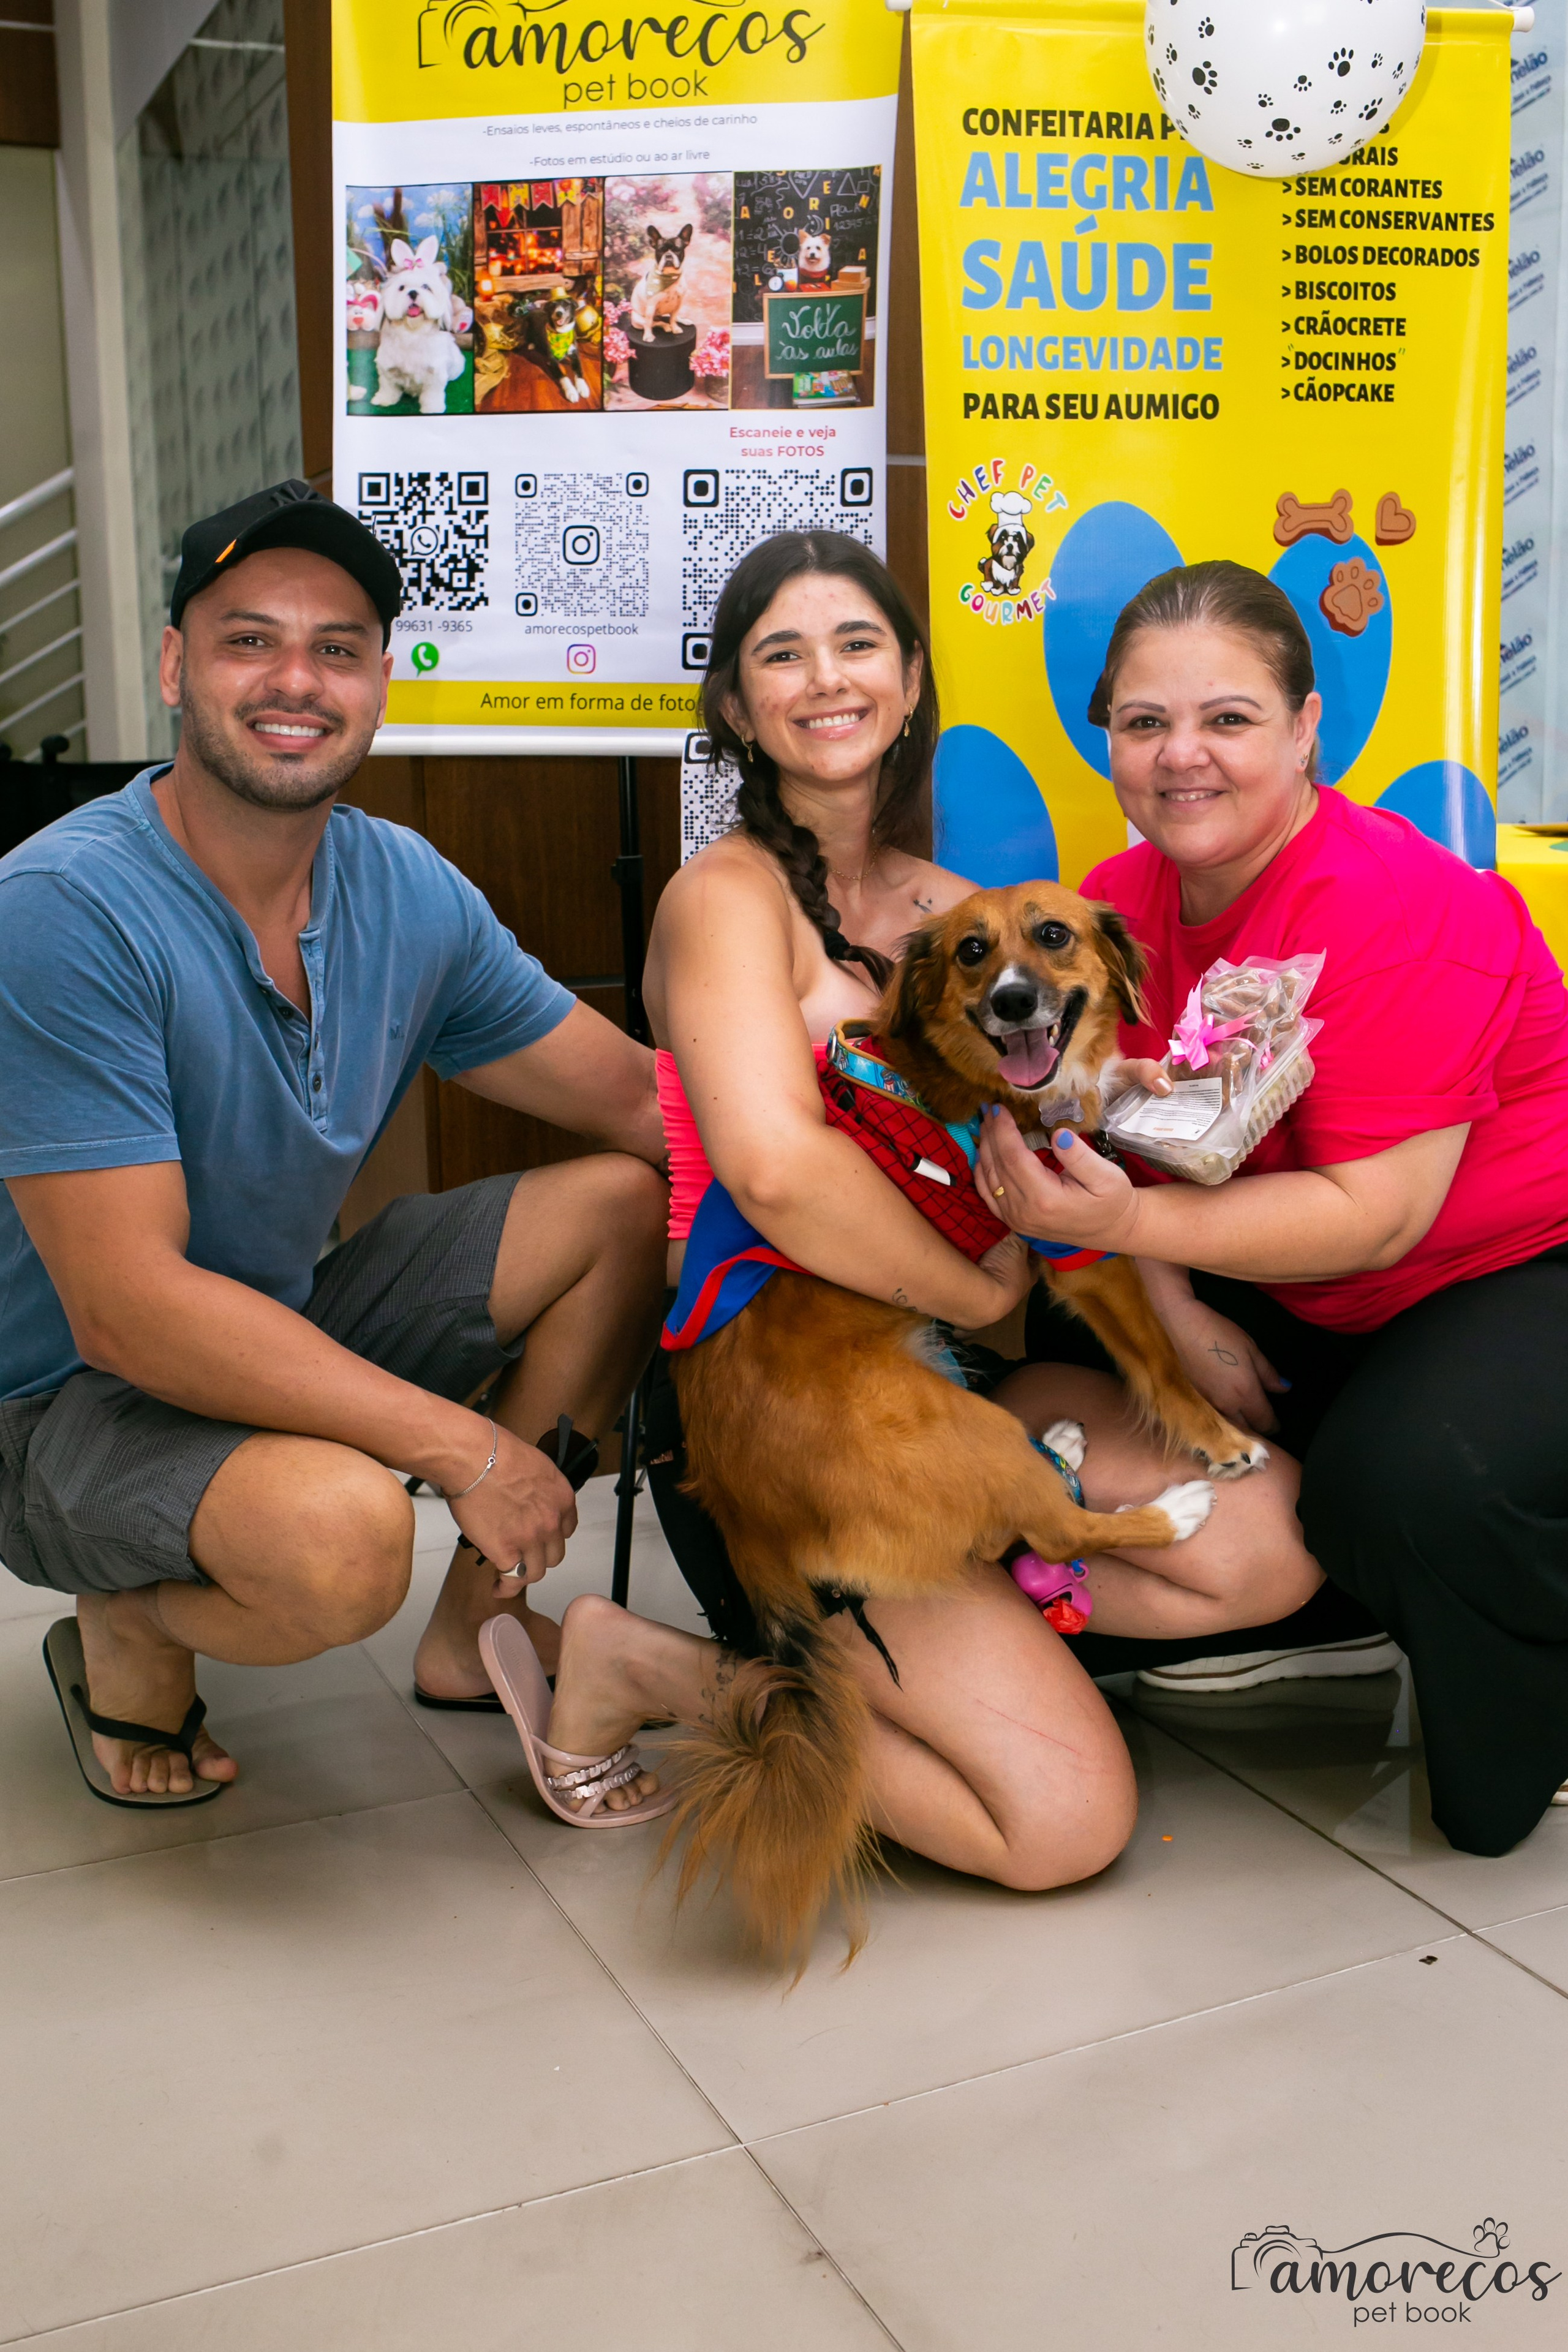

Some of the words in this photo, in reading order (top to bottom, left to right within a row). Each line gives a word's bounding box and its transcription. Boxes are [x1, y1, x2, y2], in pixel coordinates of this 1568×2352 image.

[463, 9, 826, 74] amorecos
[564, 74, 616, 108] pet
[627, 70, 708, 100] book
[532, 123, 562, 134] leves,
[565, 119, 641, 133] espontâneos
[643, 120, 650, 129] e
[653, 116, 692, 128] cheios
[693, 116, 709, 126] de
[712, 113, 758, 126] carinho
[962, 108, 1154, 140] CONFEITARIA
[567, 156, 587, 165] em
[589, 153, 633, 164] estúdio
[636, 153, 651, 162] ou
[654, 152, 669, 162] ao
[671, 152, 683, 161] ar
[685, 149, 710, 160] livre
[1339, 146, 1398, 166] RAIS
[959, 151, 1214, 211] ALEGRIA
[1295, 176, 1336, 197] SEM
[1340, 178, 1443, 199] CORANTES
[1295, 209, 1336, 228] SEM
[1340, 209, 1495, 232] CONSERVANTES
[962, 214, 1213, 311] SAÚDE
[1295, 244, 1359, 265] BOLOS
[1363, 246, 1480, 268] DECORADOS
[1295, 281, 1396, 301] BISCOITOS
[782, 303, 857, 339] Volta
[1294, 309, 1407, 337] CRÃOCRETE
[775, 340, 809, 360] às
[813, 338, 859, 359] aulas
[962, 335, 1223, 371] LONGEVIDADE
[1294, 376, 1395, 402] CÃOPCAKE
[963, 393, 1040, 420] PARA
[1045, 393, 1098, 420] SEU
[1104, 393, 1219, 420] AUMIGO
[729, 426, 792, 438] Escaneie
[796, 429, 804, 438] e
[809, 425, 836, 440] veja
[741, 448, 773, 457] suas
[777, 445, 824, 457] FOTOS
[949, 459, 1003, 519] CHEF
[1020, 466, 1066, 511] PET
[960, 579, 1057, 624] GOURMET
[395, 620, 433, 632] 99631
[524, 623, 639, 637] amorecospetbook
[480, 693, 530, 709] Amor
[536, 696, 564, 709] em
[570, 693, 624, 710] forma
[630, 694, 653, 710] de
[658, 693, 699, 712] foto
